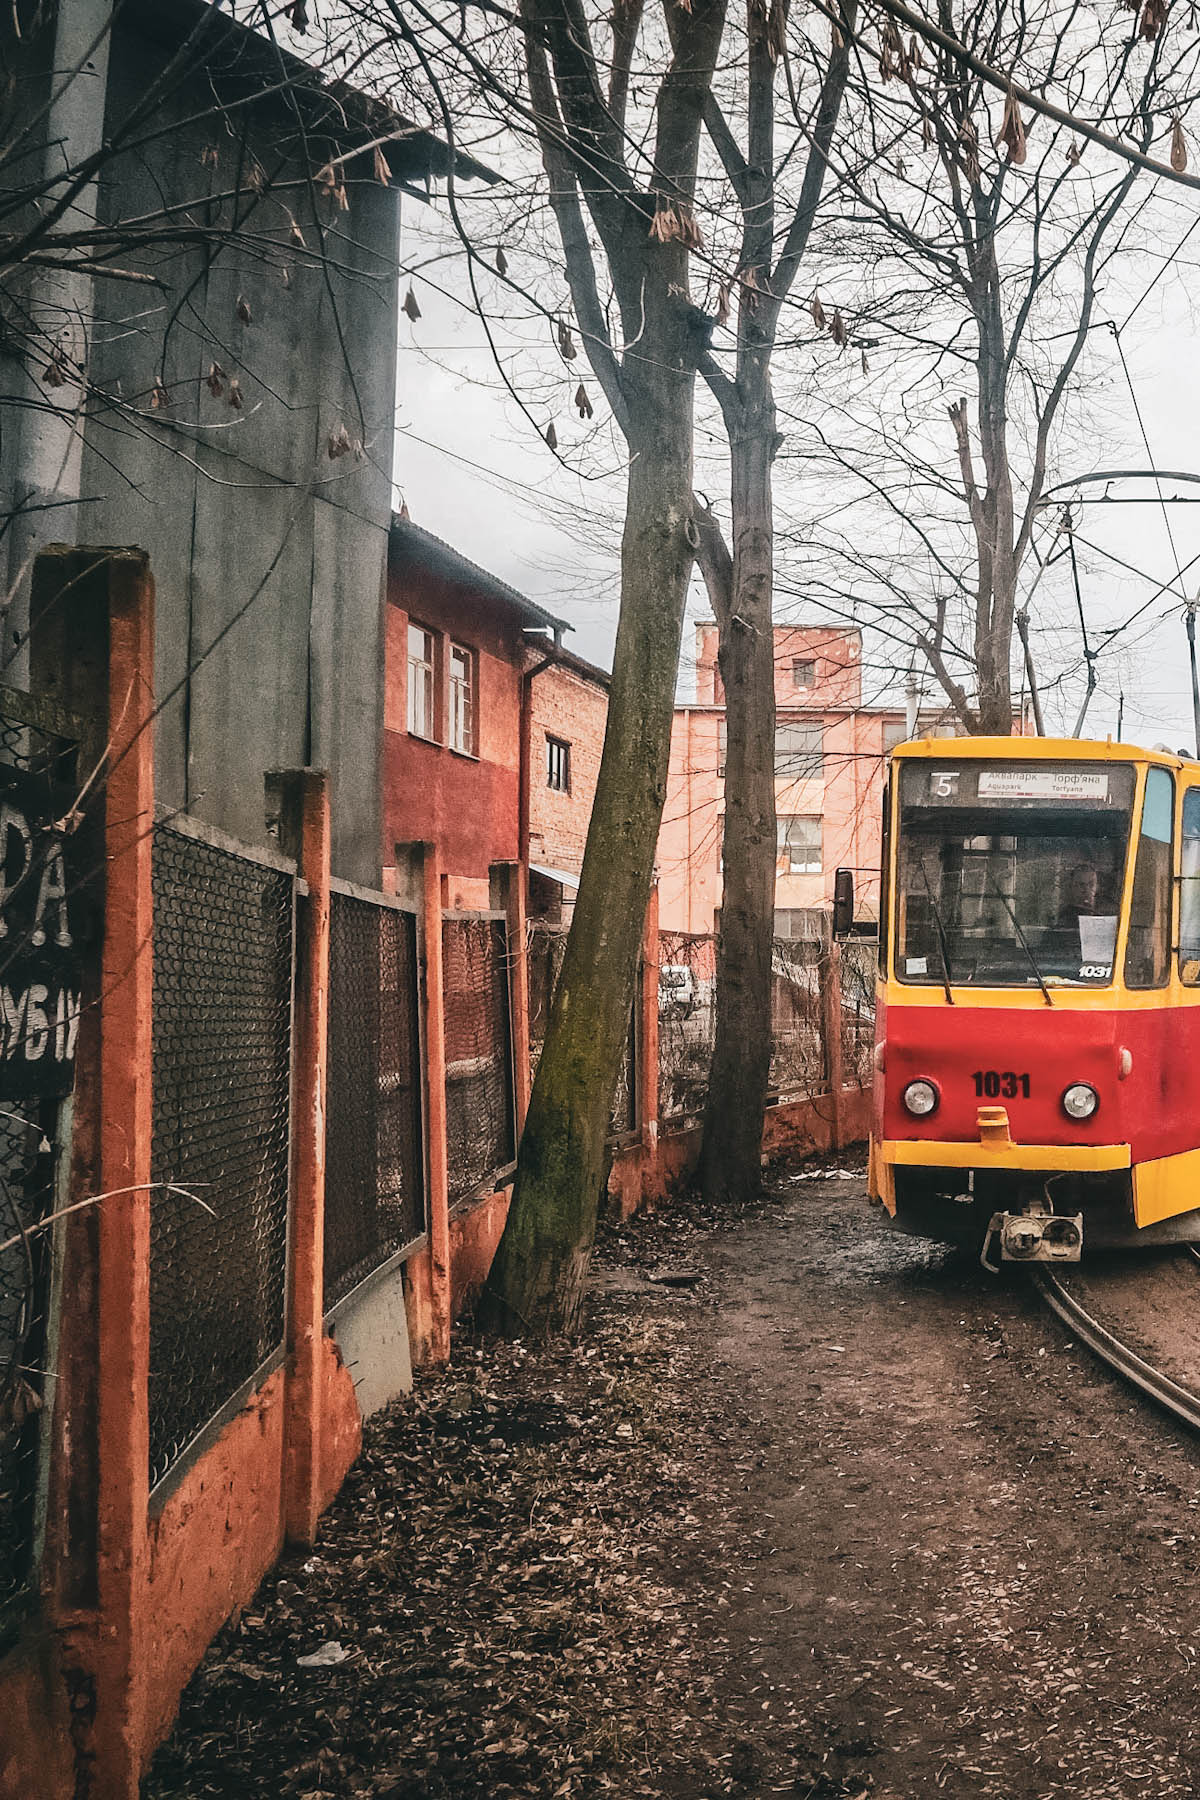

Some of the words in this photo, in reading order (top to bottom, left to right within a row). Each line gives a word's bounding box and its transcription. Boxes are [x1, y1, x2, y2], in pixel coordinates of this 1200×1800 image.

[937, 776, 952, 797] 5
[1078, 965, 1112, 978] 1031
[970, 1070, 1030, 1099] 1031
